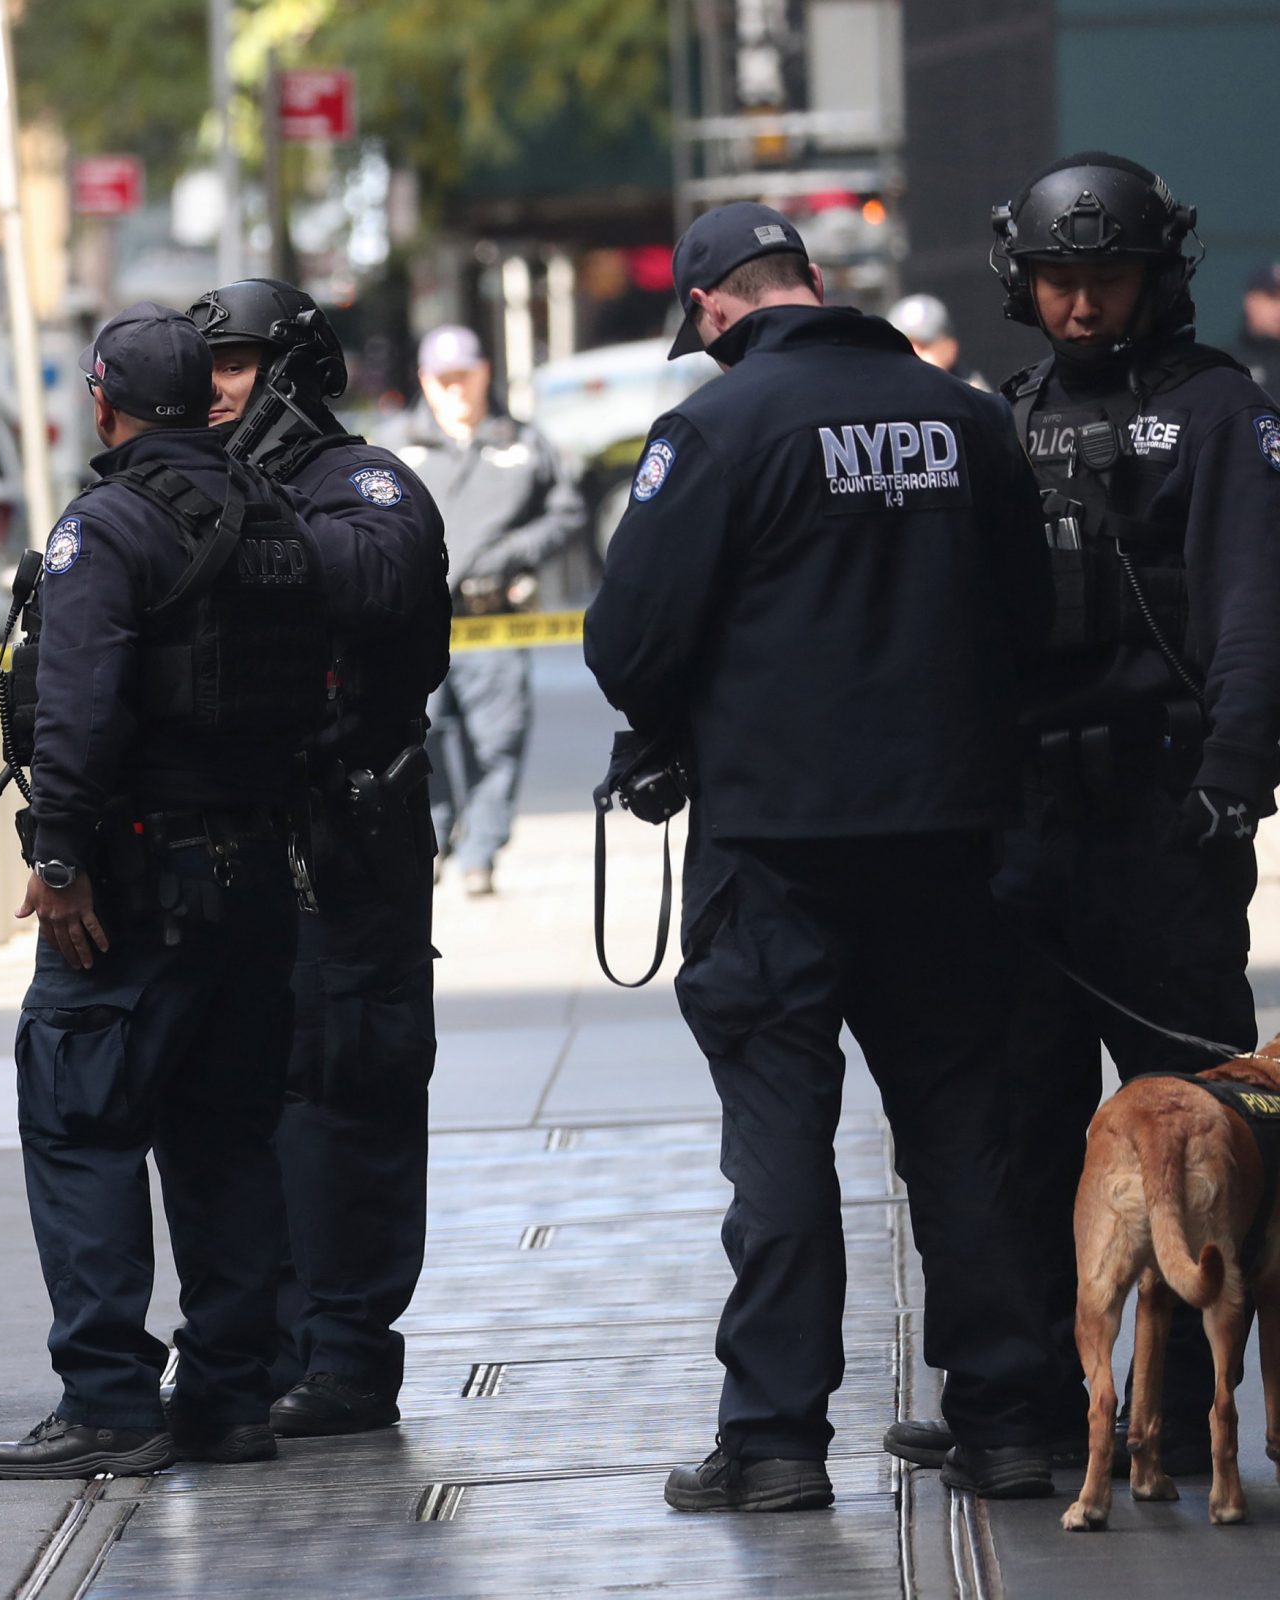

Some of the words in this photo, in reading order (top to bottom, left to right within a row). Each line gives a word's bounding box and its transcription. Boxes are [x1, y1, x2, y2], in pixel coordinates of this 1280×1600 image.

[818, 421, 958, 478] NYPD
[355, 470, 394, 483] POLICE
[829, 471, 959, 494] COUNTERTERRORISM
[885, 491, 904, 507] K-9
[240, 539, 307, 575] NYPD
